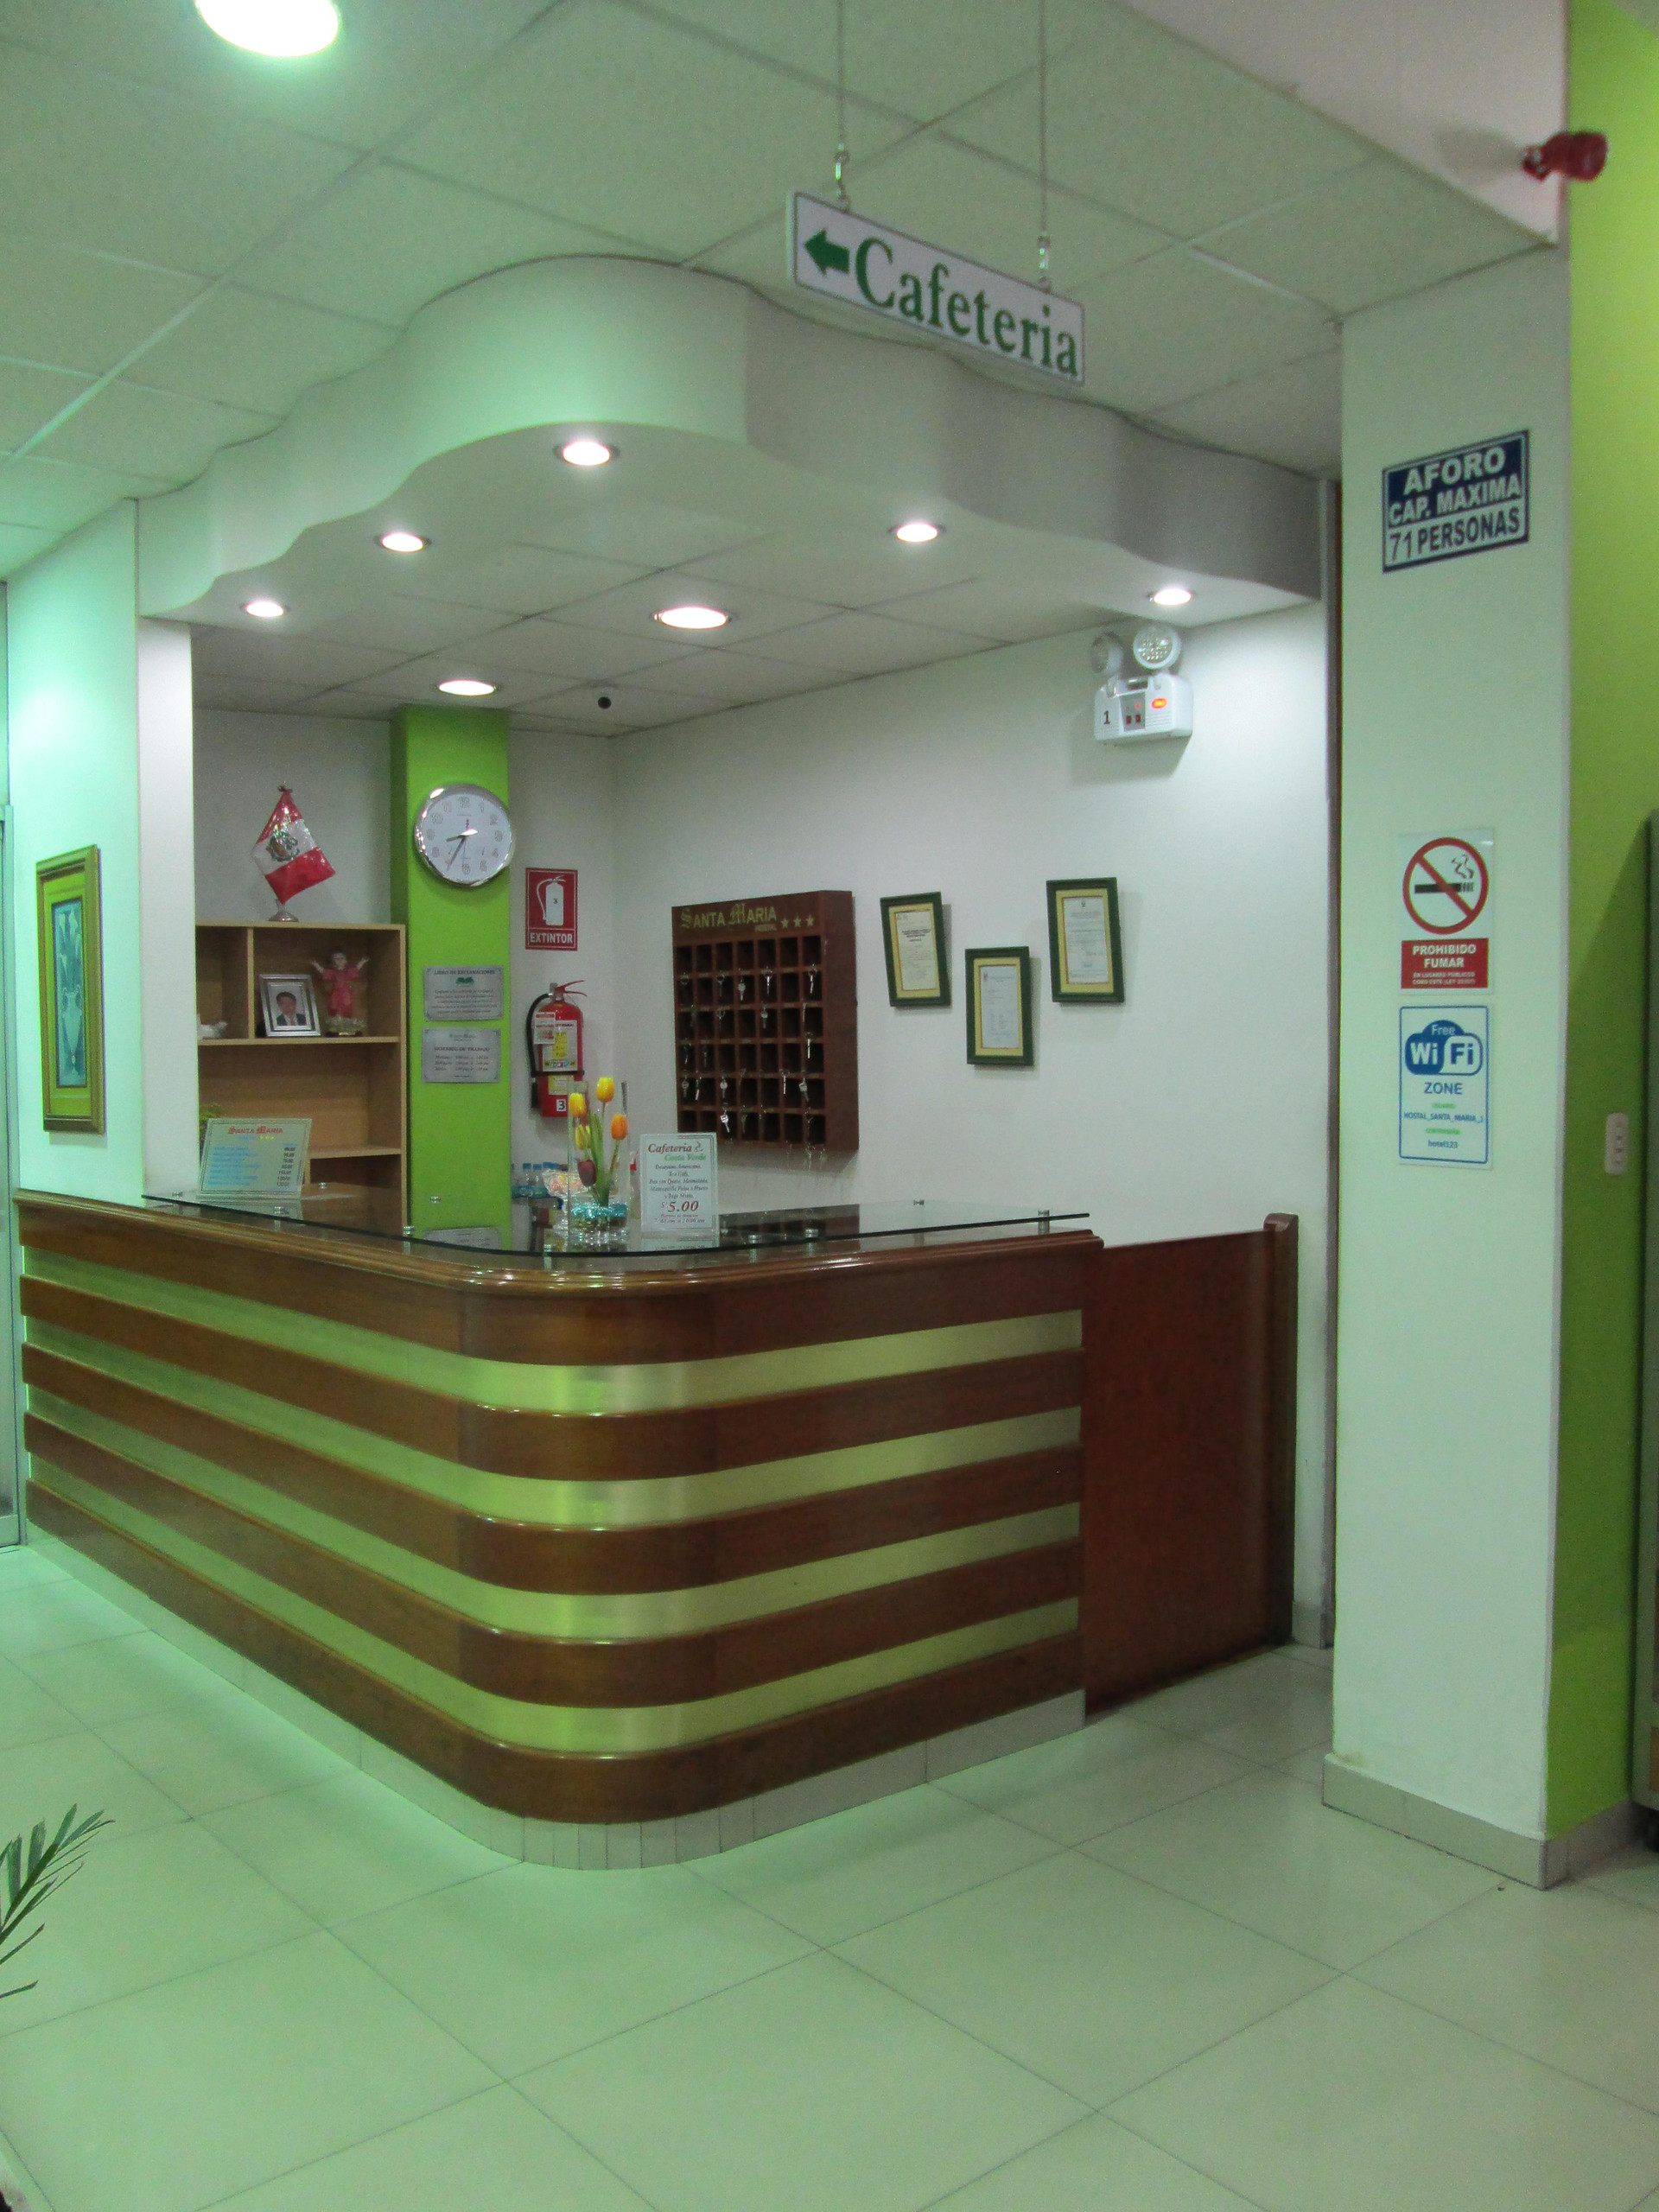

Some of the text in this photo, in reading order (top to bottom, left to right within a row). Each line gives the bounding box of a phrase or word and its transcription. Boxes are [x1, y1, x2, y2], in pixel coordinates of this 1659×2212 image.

[855, 237, 1078, 376] Cafeteria
[1402, 446, 1506, 496] AFORO
[1388, 474, 1522, 526] CAP. MAXIMA
[1389, 506, 1521, 562] 71 PERSONAS
[1103, 710, 1110, 724] 1
[680, 903, 777, 929] SANTA MARIA
[530, 932, 574, 944] EXTINTOR
[1412, 944, 1477, 956] PROHIBIDO
[1424, 957, 1465, 969] FUMAR
[1431, 1024, 1456, 1036] Free
[1424, 1082, 1463, 1095] ZONE
[557, 1100, 565, 1110] 3
[228, 1126, 255, 1135] SANTA
[648, 1142, 692, 1154] Cafeteria
[1428, 1140, 1459, 1148] hotel123
